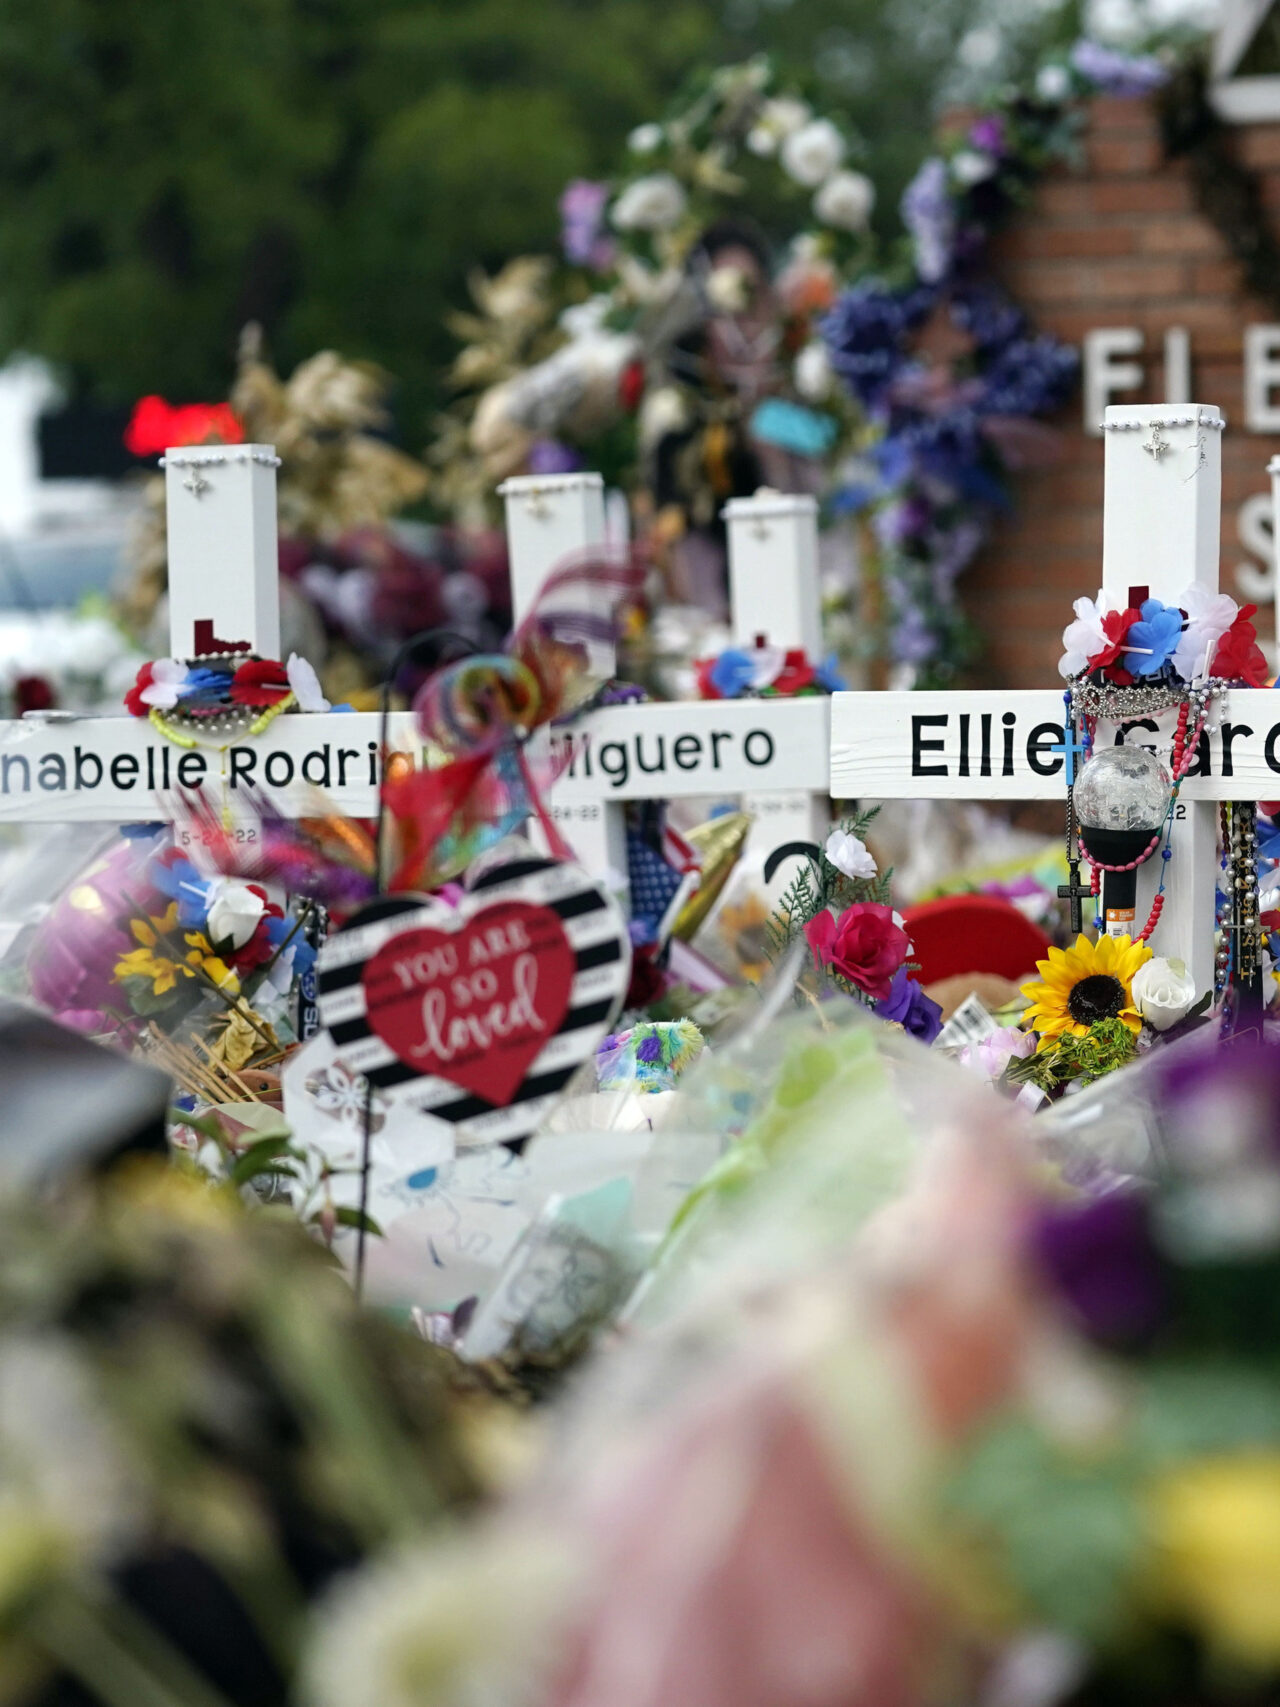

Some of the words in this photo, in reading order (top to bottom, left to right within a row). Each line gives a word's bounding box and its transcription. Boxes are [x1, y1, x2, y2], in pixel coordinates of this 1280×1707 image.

[551, 727, 775, 788] ilguero
[911, 711, 1066, 777] Ellie
[392, 943, 459, 990] YOU
[468, 919, 531, 966] ARE
[452, 968, 498, 1006] SO
[411, 952, 545, 1061] loved
